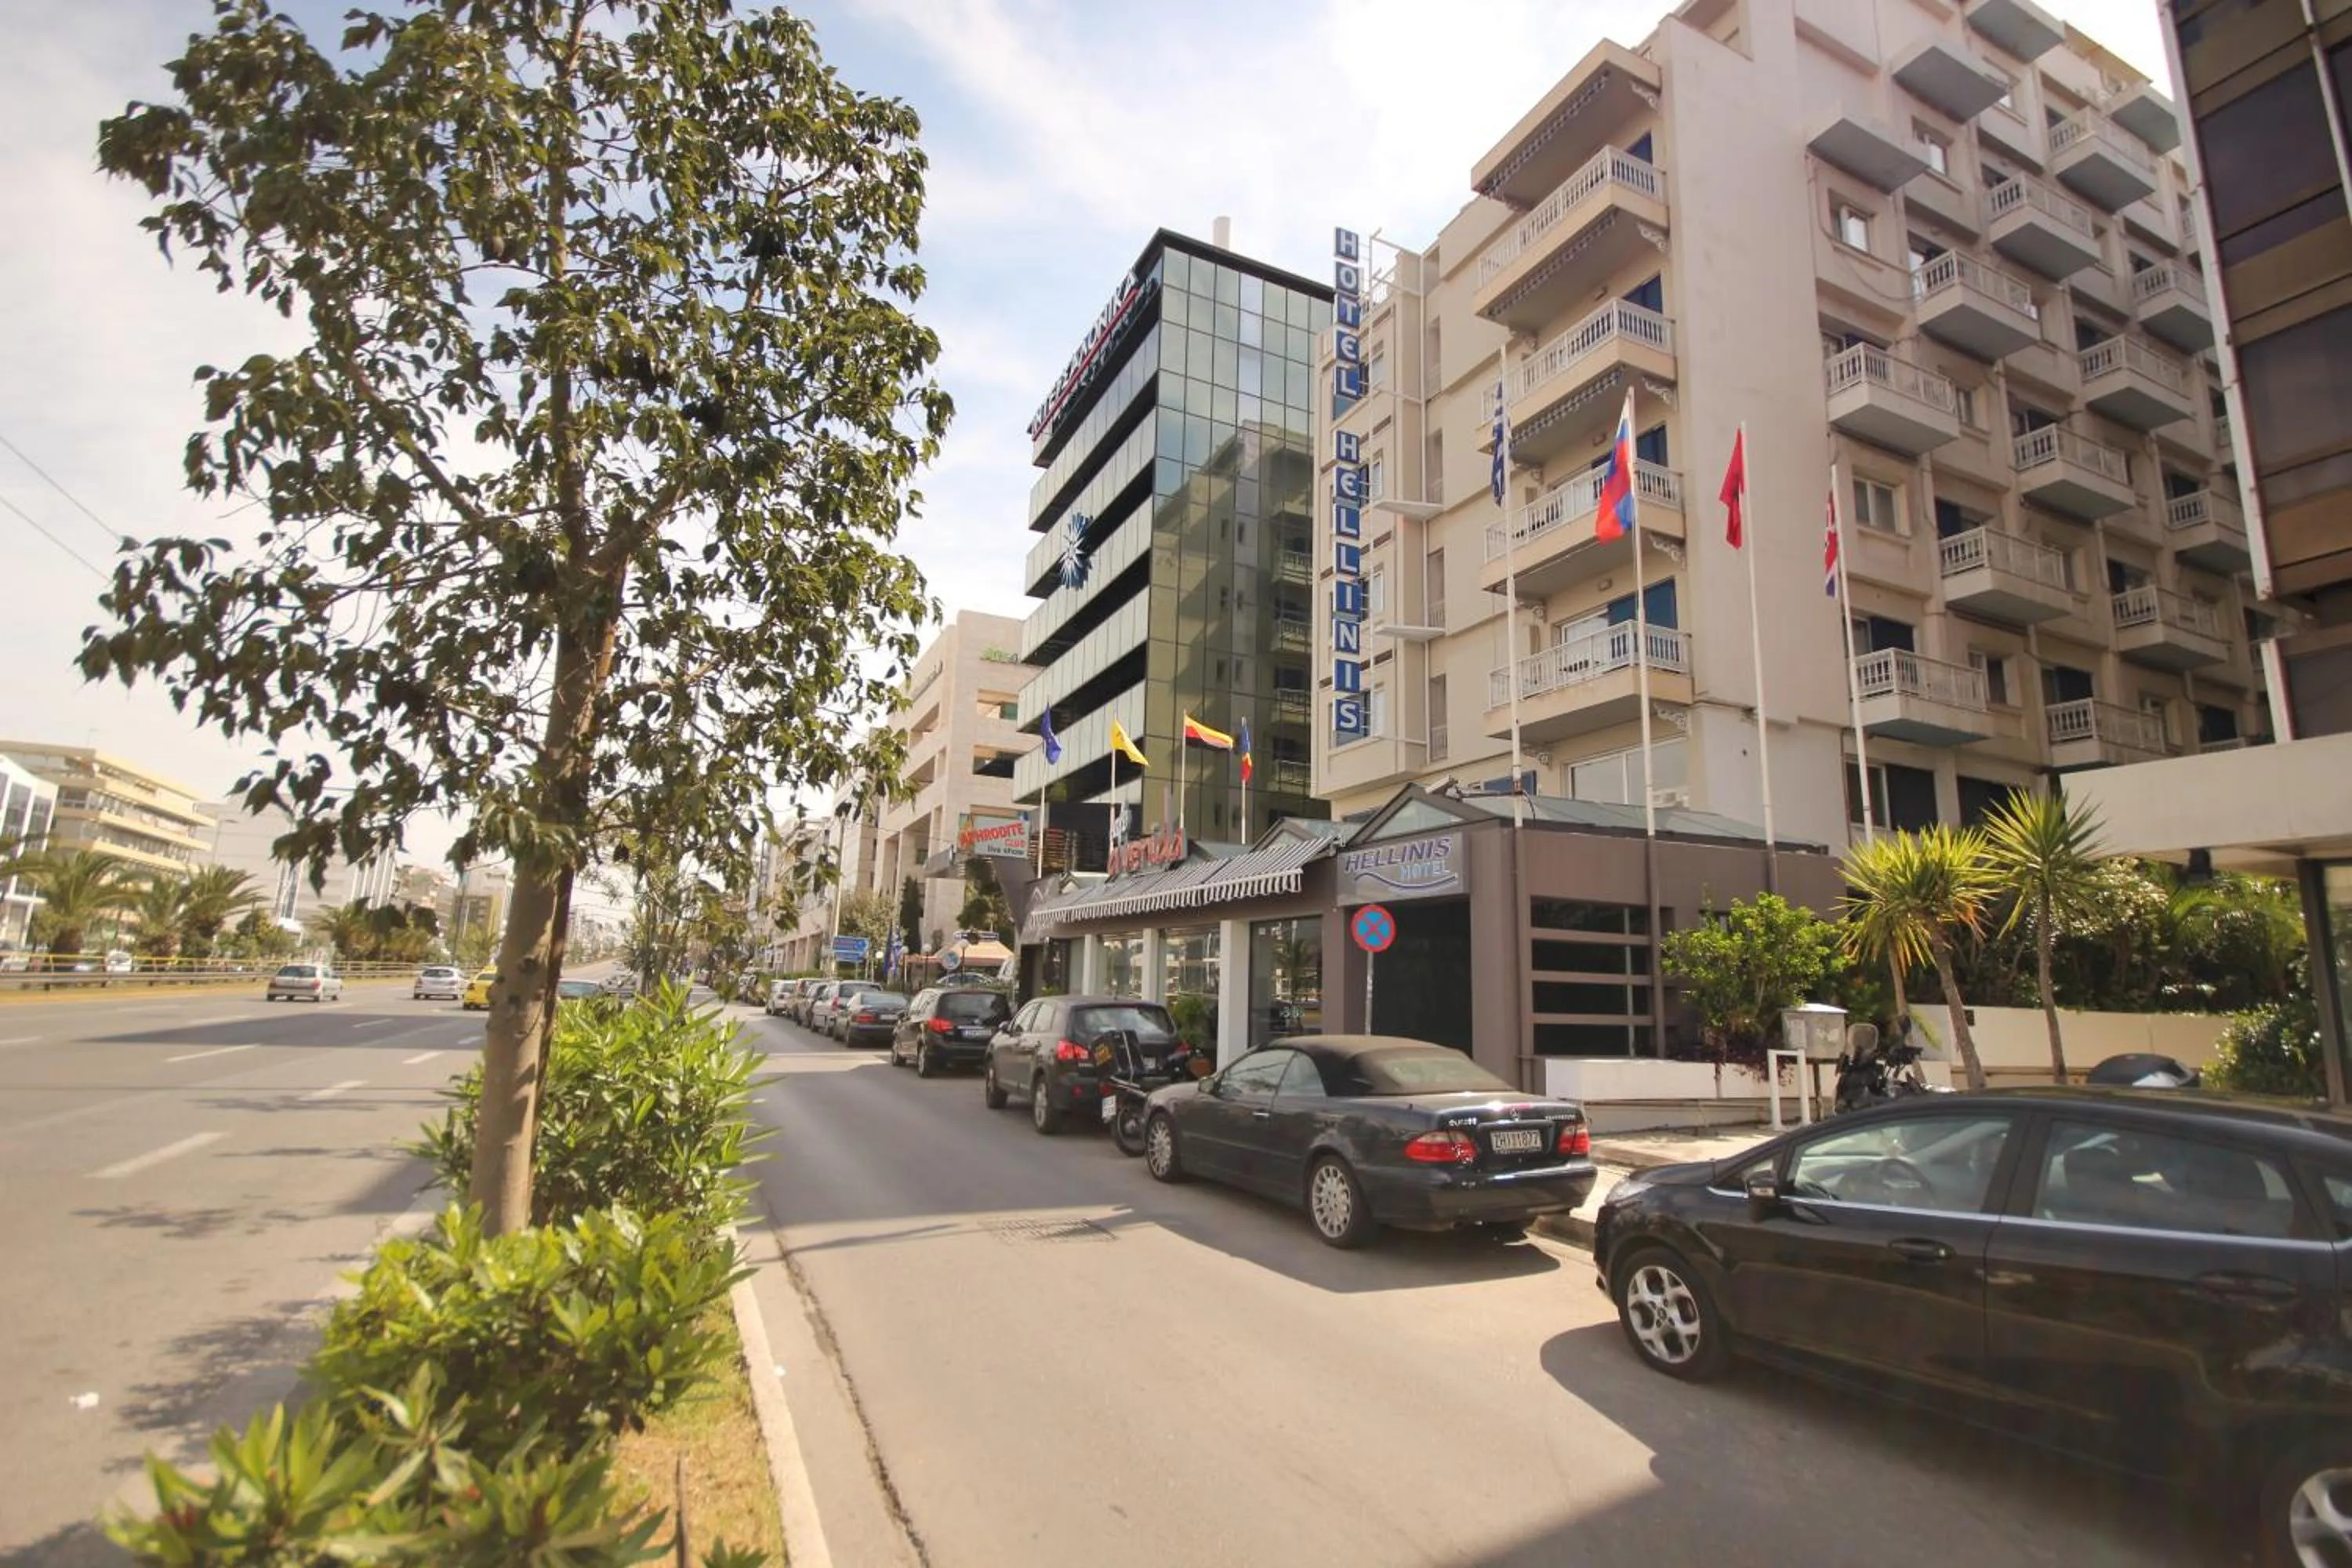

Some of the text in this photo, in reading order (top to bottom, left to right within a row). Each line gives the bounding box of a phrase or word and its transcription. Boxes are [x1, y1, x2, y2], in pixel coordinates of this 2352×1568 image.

[1338, 229, 1359, 730] HOTEL HELLINIS
[1345, 837, 1451, 872] HELLINIS
[1399, 859, 1450, 880] HOTEL
